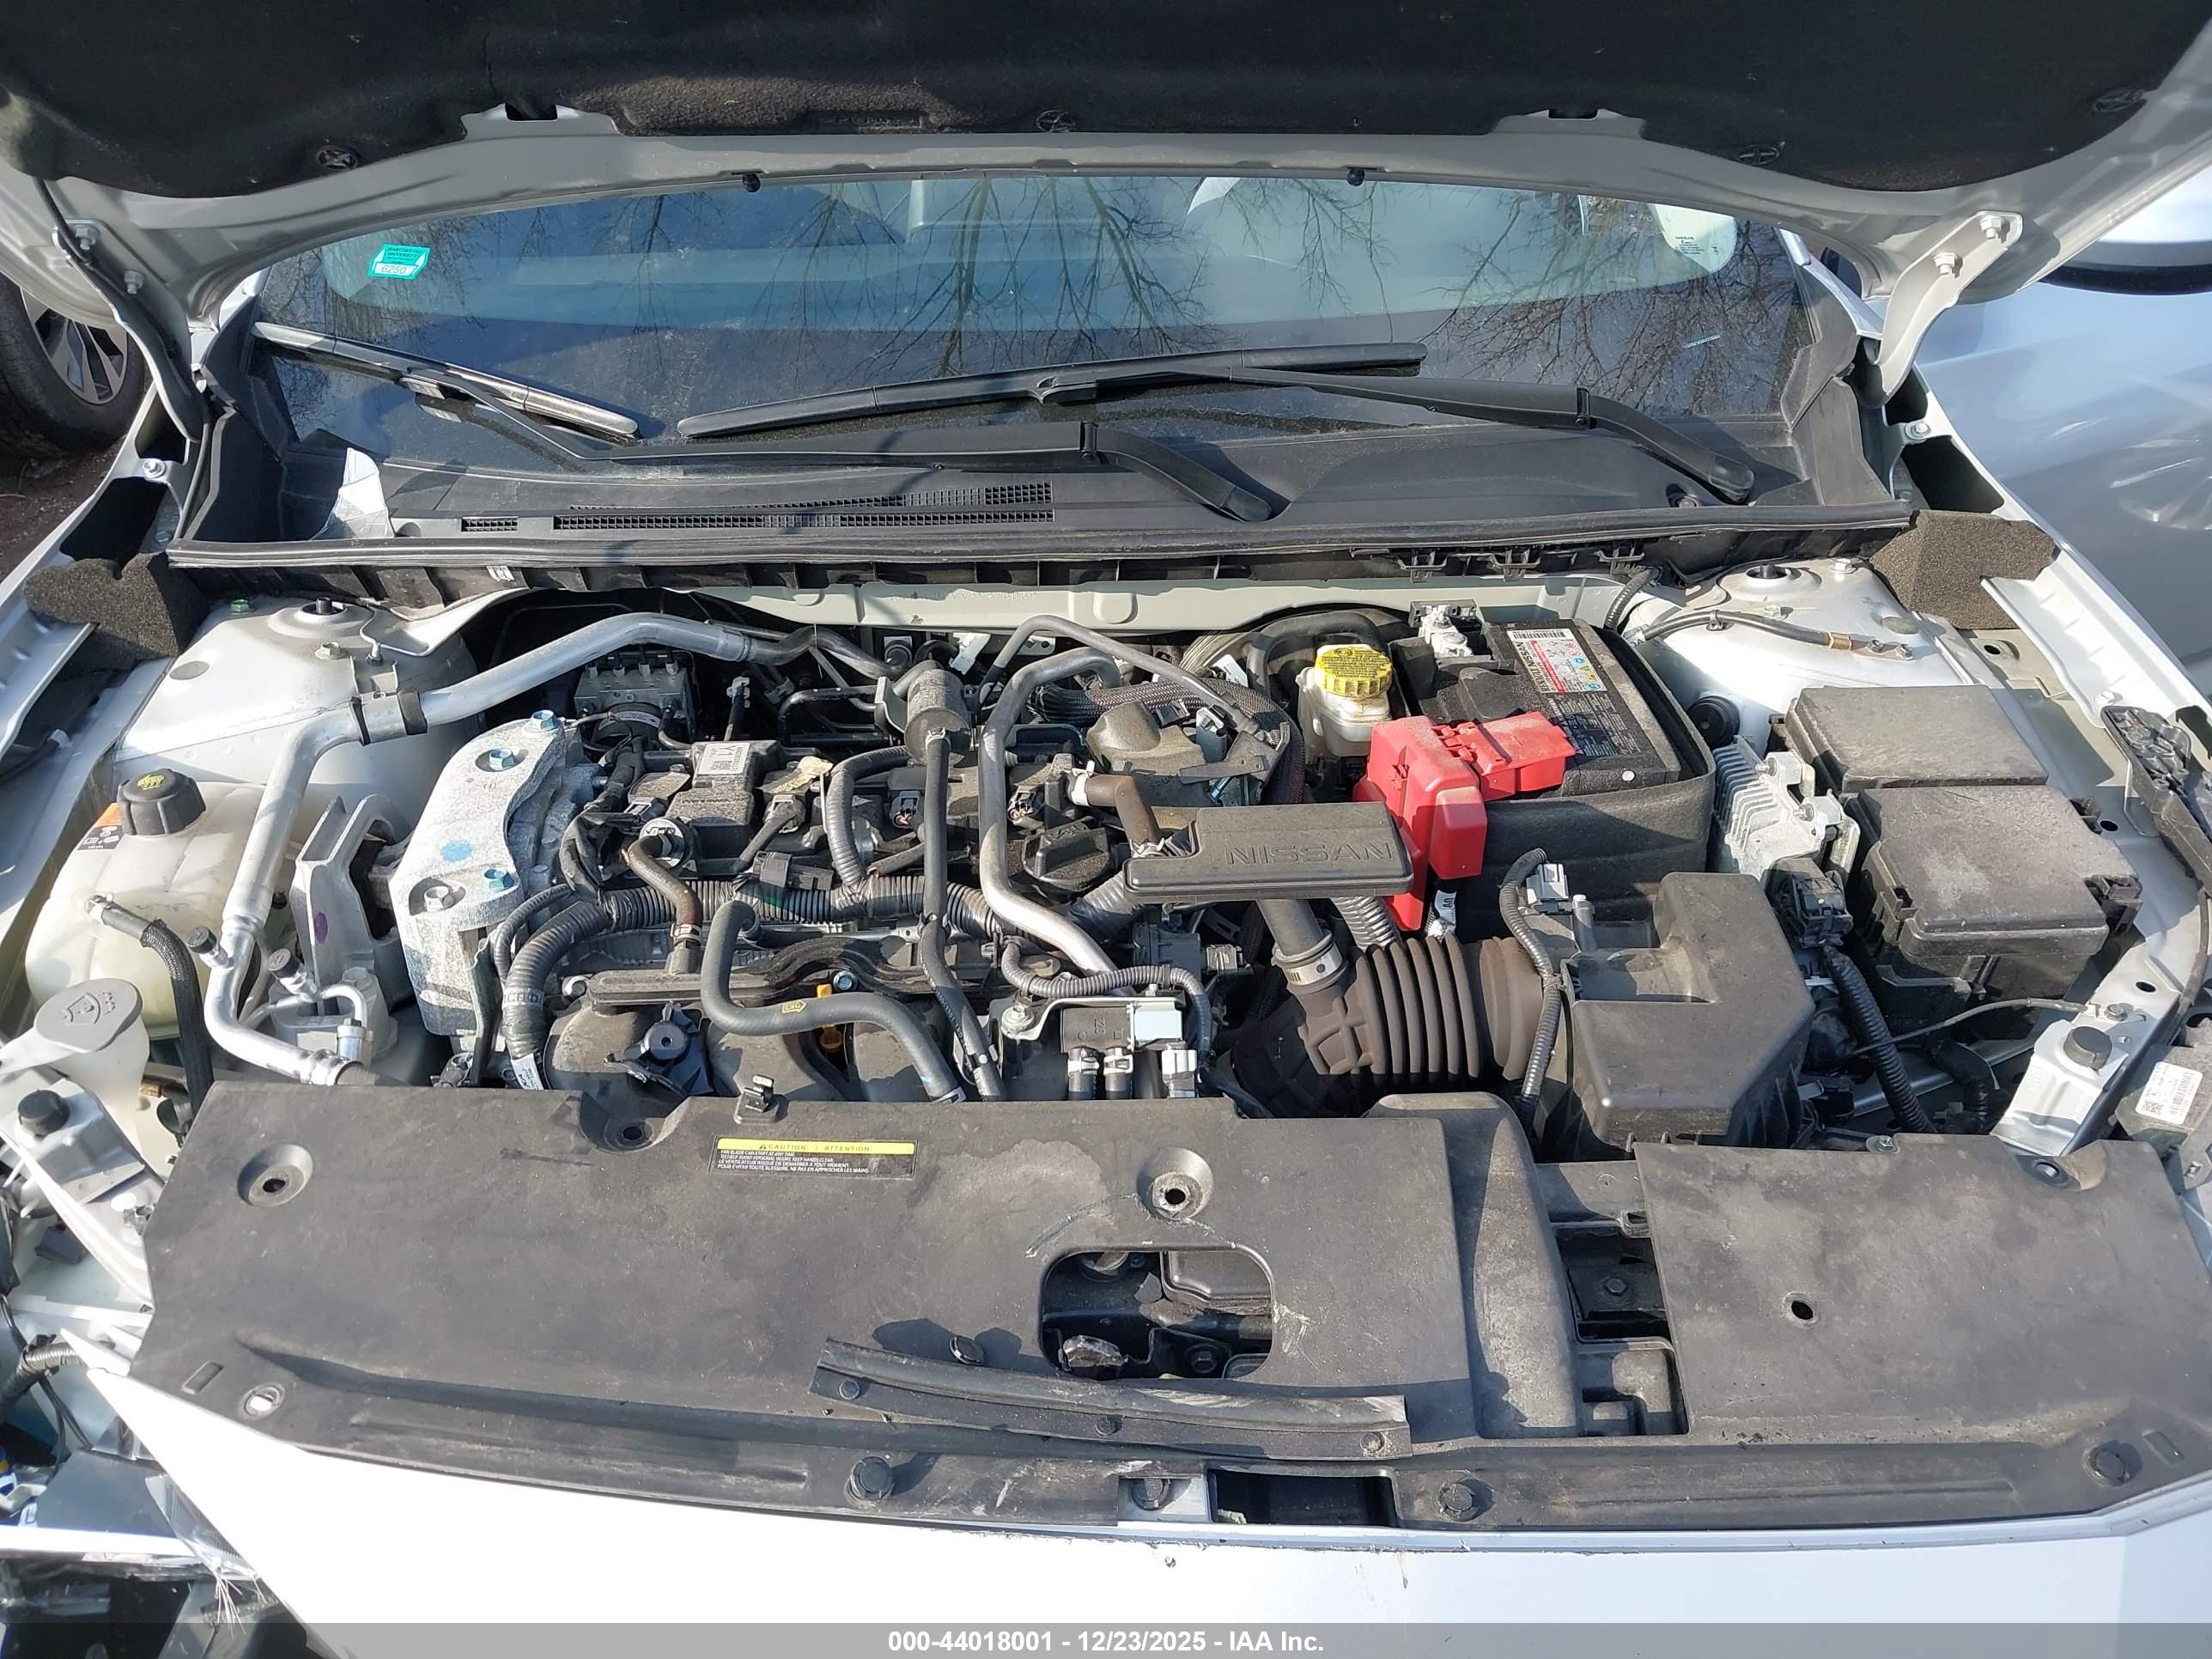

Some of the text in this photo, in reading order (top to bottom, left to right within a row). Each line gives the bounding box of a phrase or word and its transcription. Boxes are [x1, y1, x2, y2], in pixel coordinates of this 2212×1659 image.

[381, 264, 407, 274] 6250
[1515, 641, 1534, 667] NISSAN
[1223, 842, 1394, 866] NISSAN
